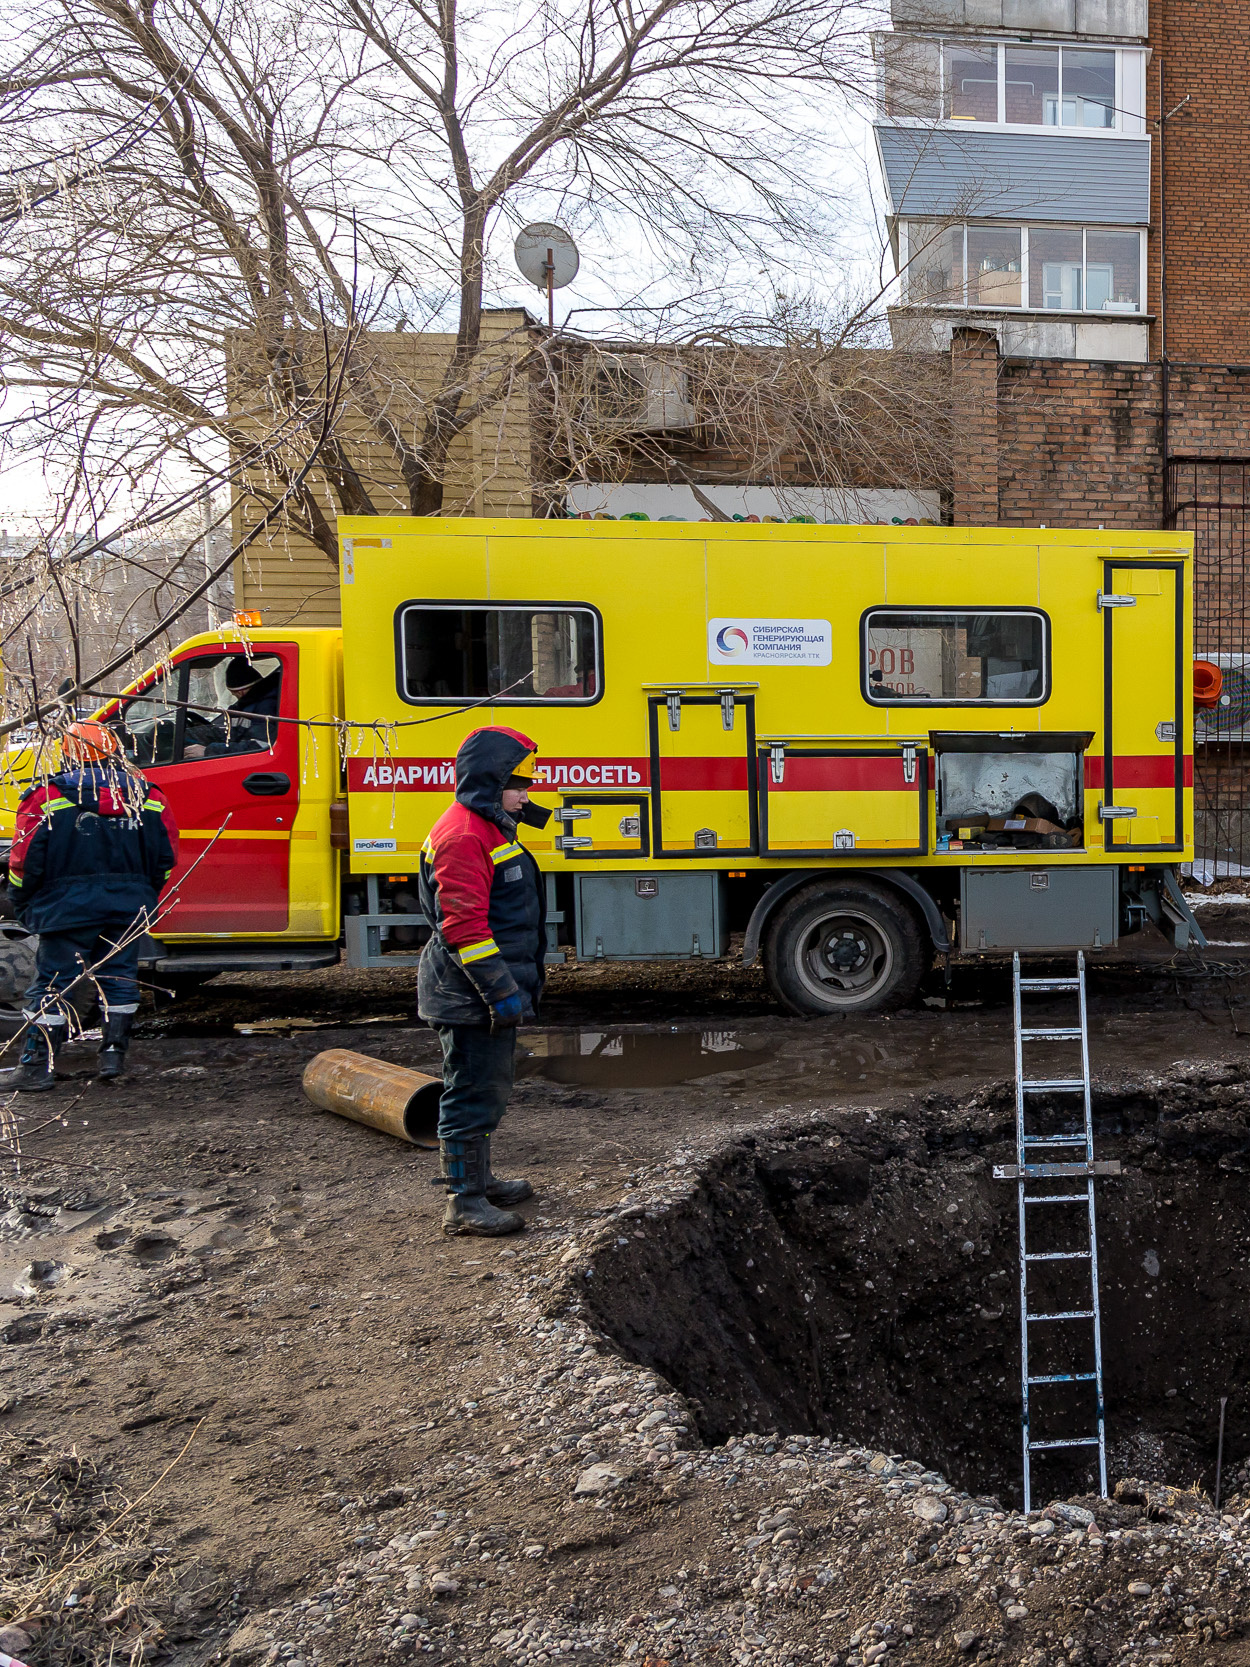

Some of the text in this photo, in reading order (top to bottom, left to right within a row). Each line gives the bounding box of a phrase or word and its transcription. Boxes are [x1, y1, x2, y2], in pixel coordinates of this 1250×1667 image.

[752, 625, 804, 634] СИБИРСКАЯ
[752, 634, 824, 644] ГЕНЕРИРУЮЩАЯ
[752, 643, 802, 651] КОМПАНИЯ
[363, 762, 641, 785] АВАРИЙ ПЛОСЕТЬ
